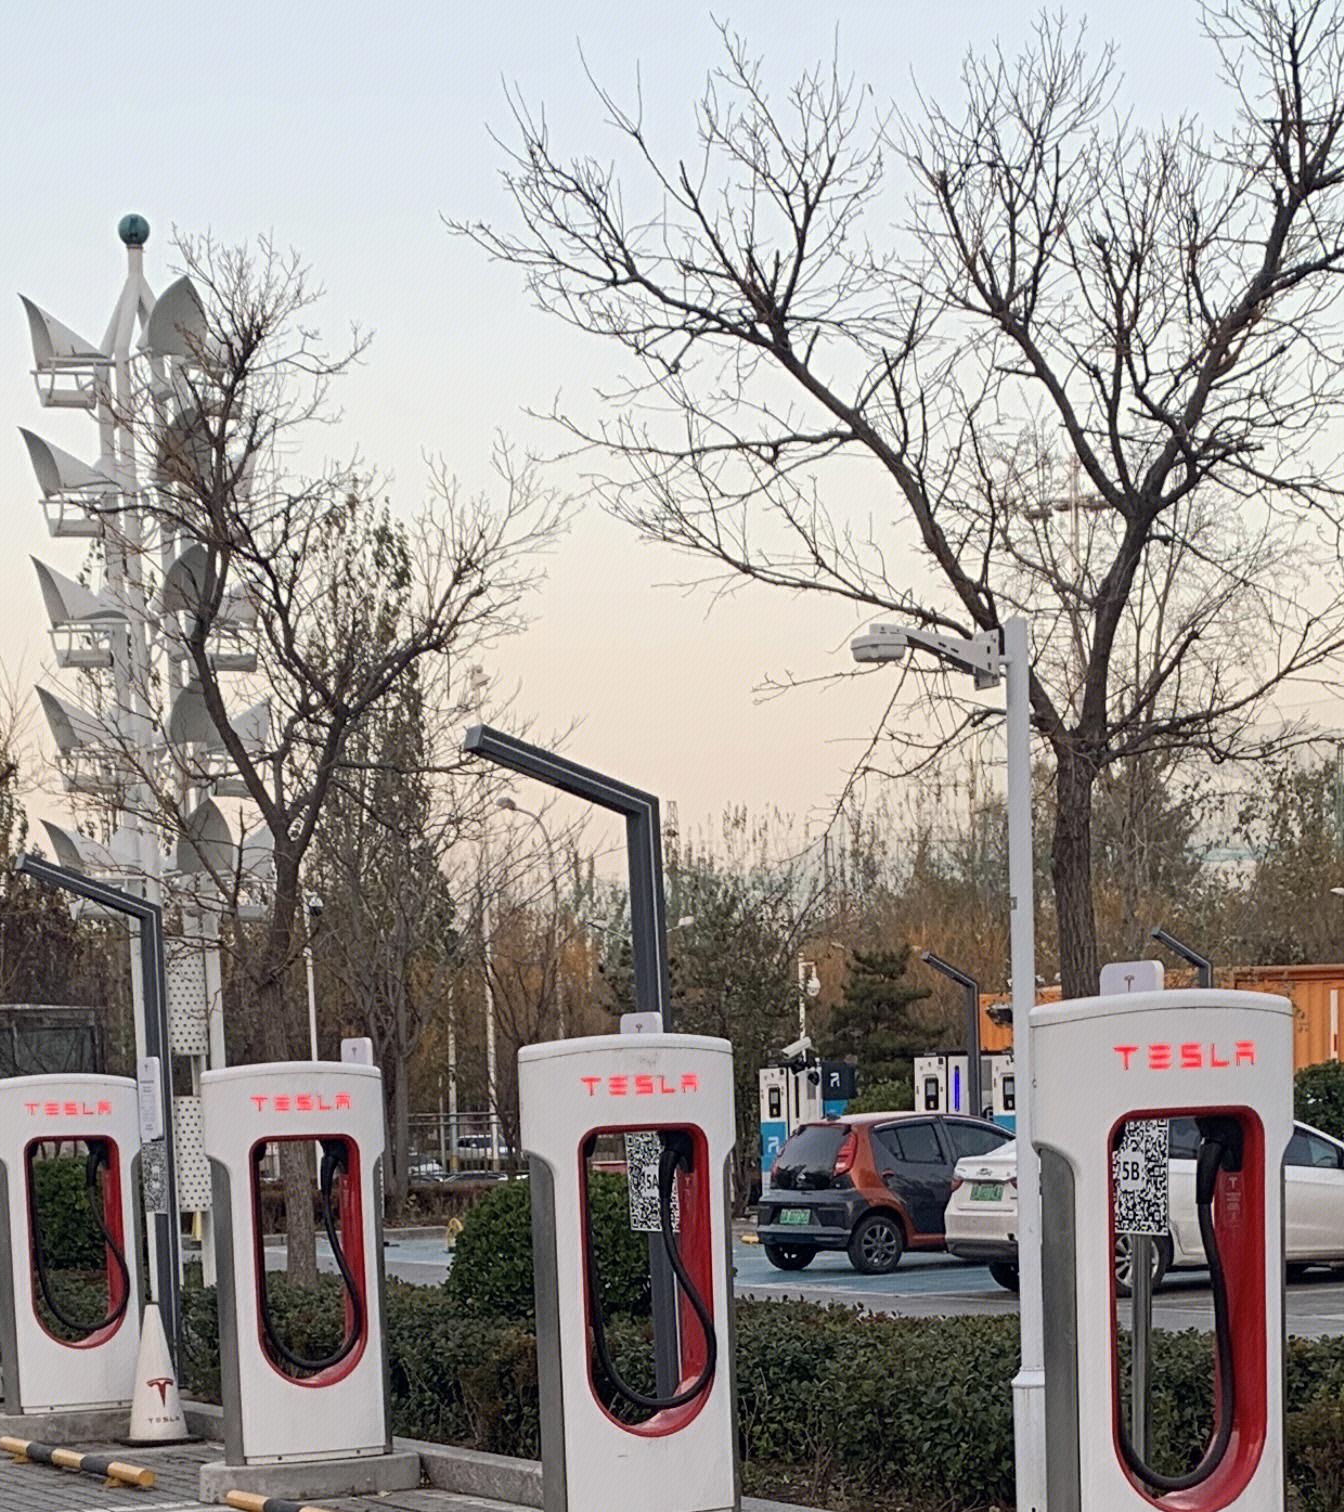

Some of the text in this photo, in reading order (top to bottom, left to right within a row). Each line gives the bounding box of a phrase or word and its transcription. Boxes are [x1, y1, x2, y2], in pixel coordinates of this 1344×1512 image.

[1113, 1041, 1256, 1071] TESLA
[580, 1072, 700, 1097] TESLA
[25, 1102, 112, 1116] TESLA
[250, 1093, 353, 1112] TESLA
[1122, 1161, 1140, 1181] 5B
[148, 1416, 180, 1424] TESLA
